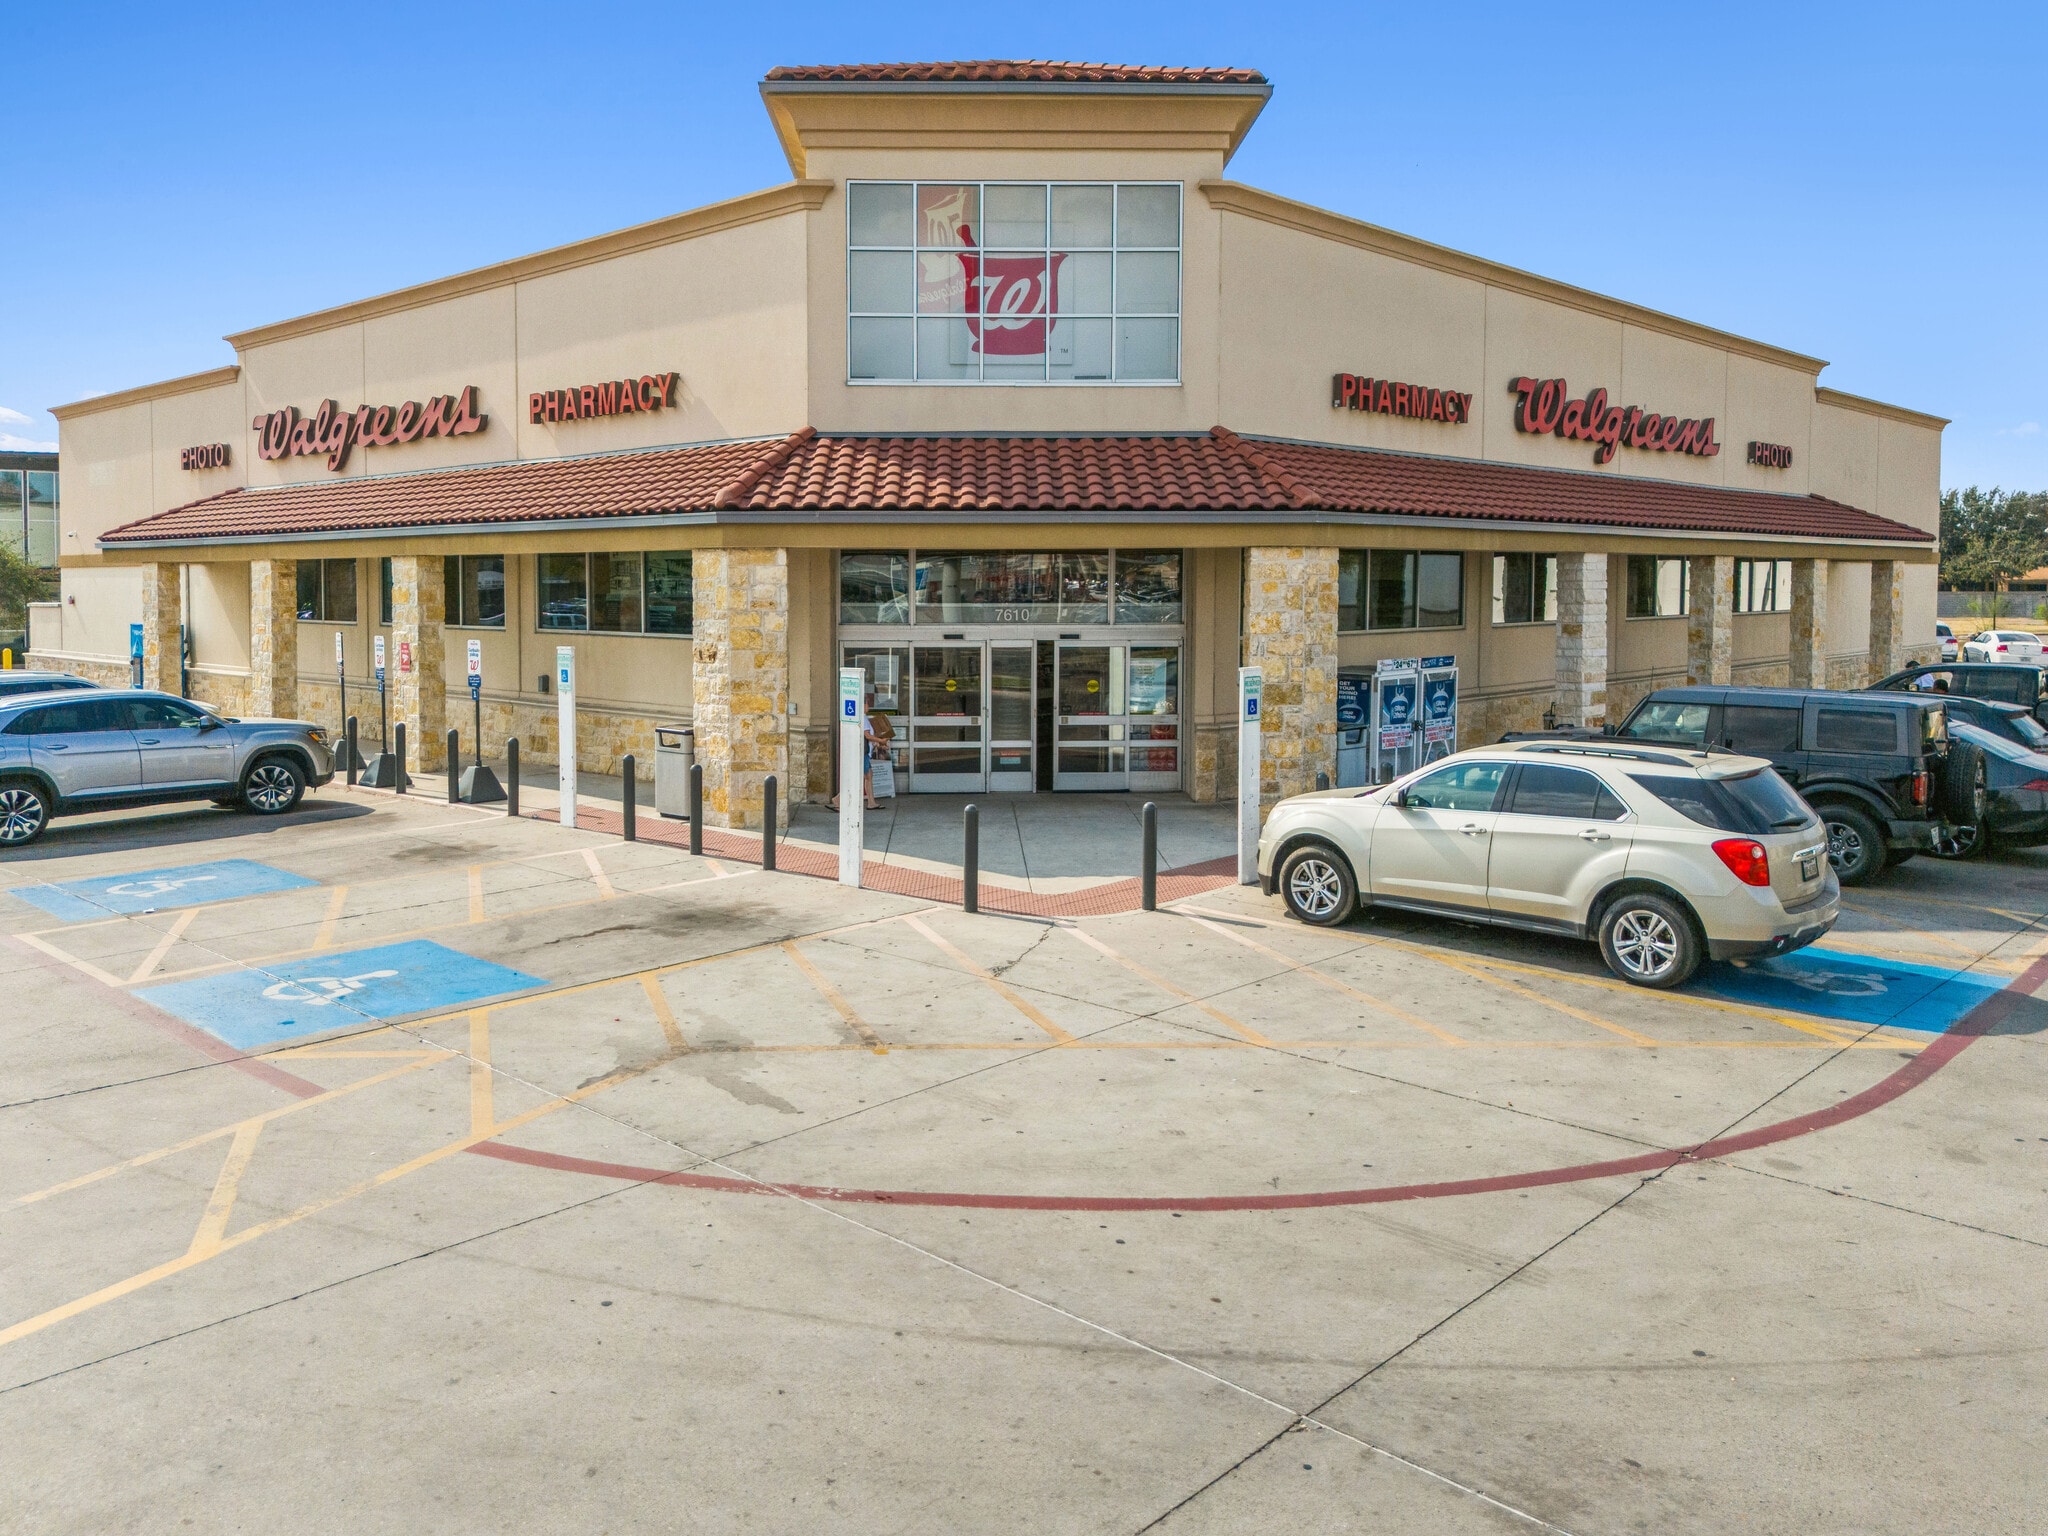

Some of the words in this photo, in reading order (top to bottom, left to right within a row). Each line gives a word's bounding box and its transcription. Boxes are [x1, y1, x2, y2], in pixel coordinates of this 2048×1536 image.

[530, 372, 678, 424] PHARMACY
[1334, 373, 1473, 423] PHARMACY
[1508, 376, 1721, 464] Walgreens
[253, 385, 487, 472] Walgreens
[181, 442, 229, 470] PHOTO
[1749, 440, 1793, 468] PHOTO
[994, 608, 1030, 621] 7610
